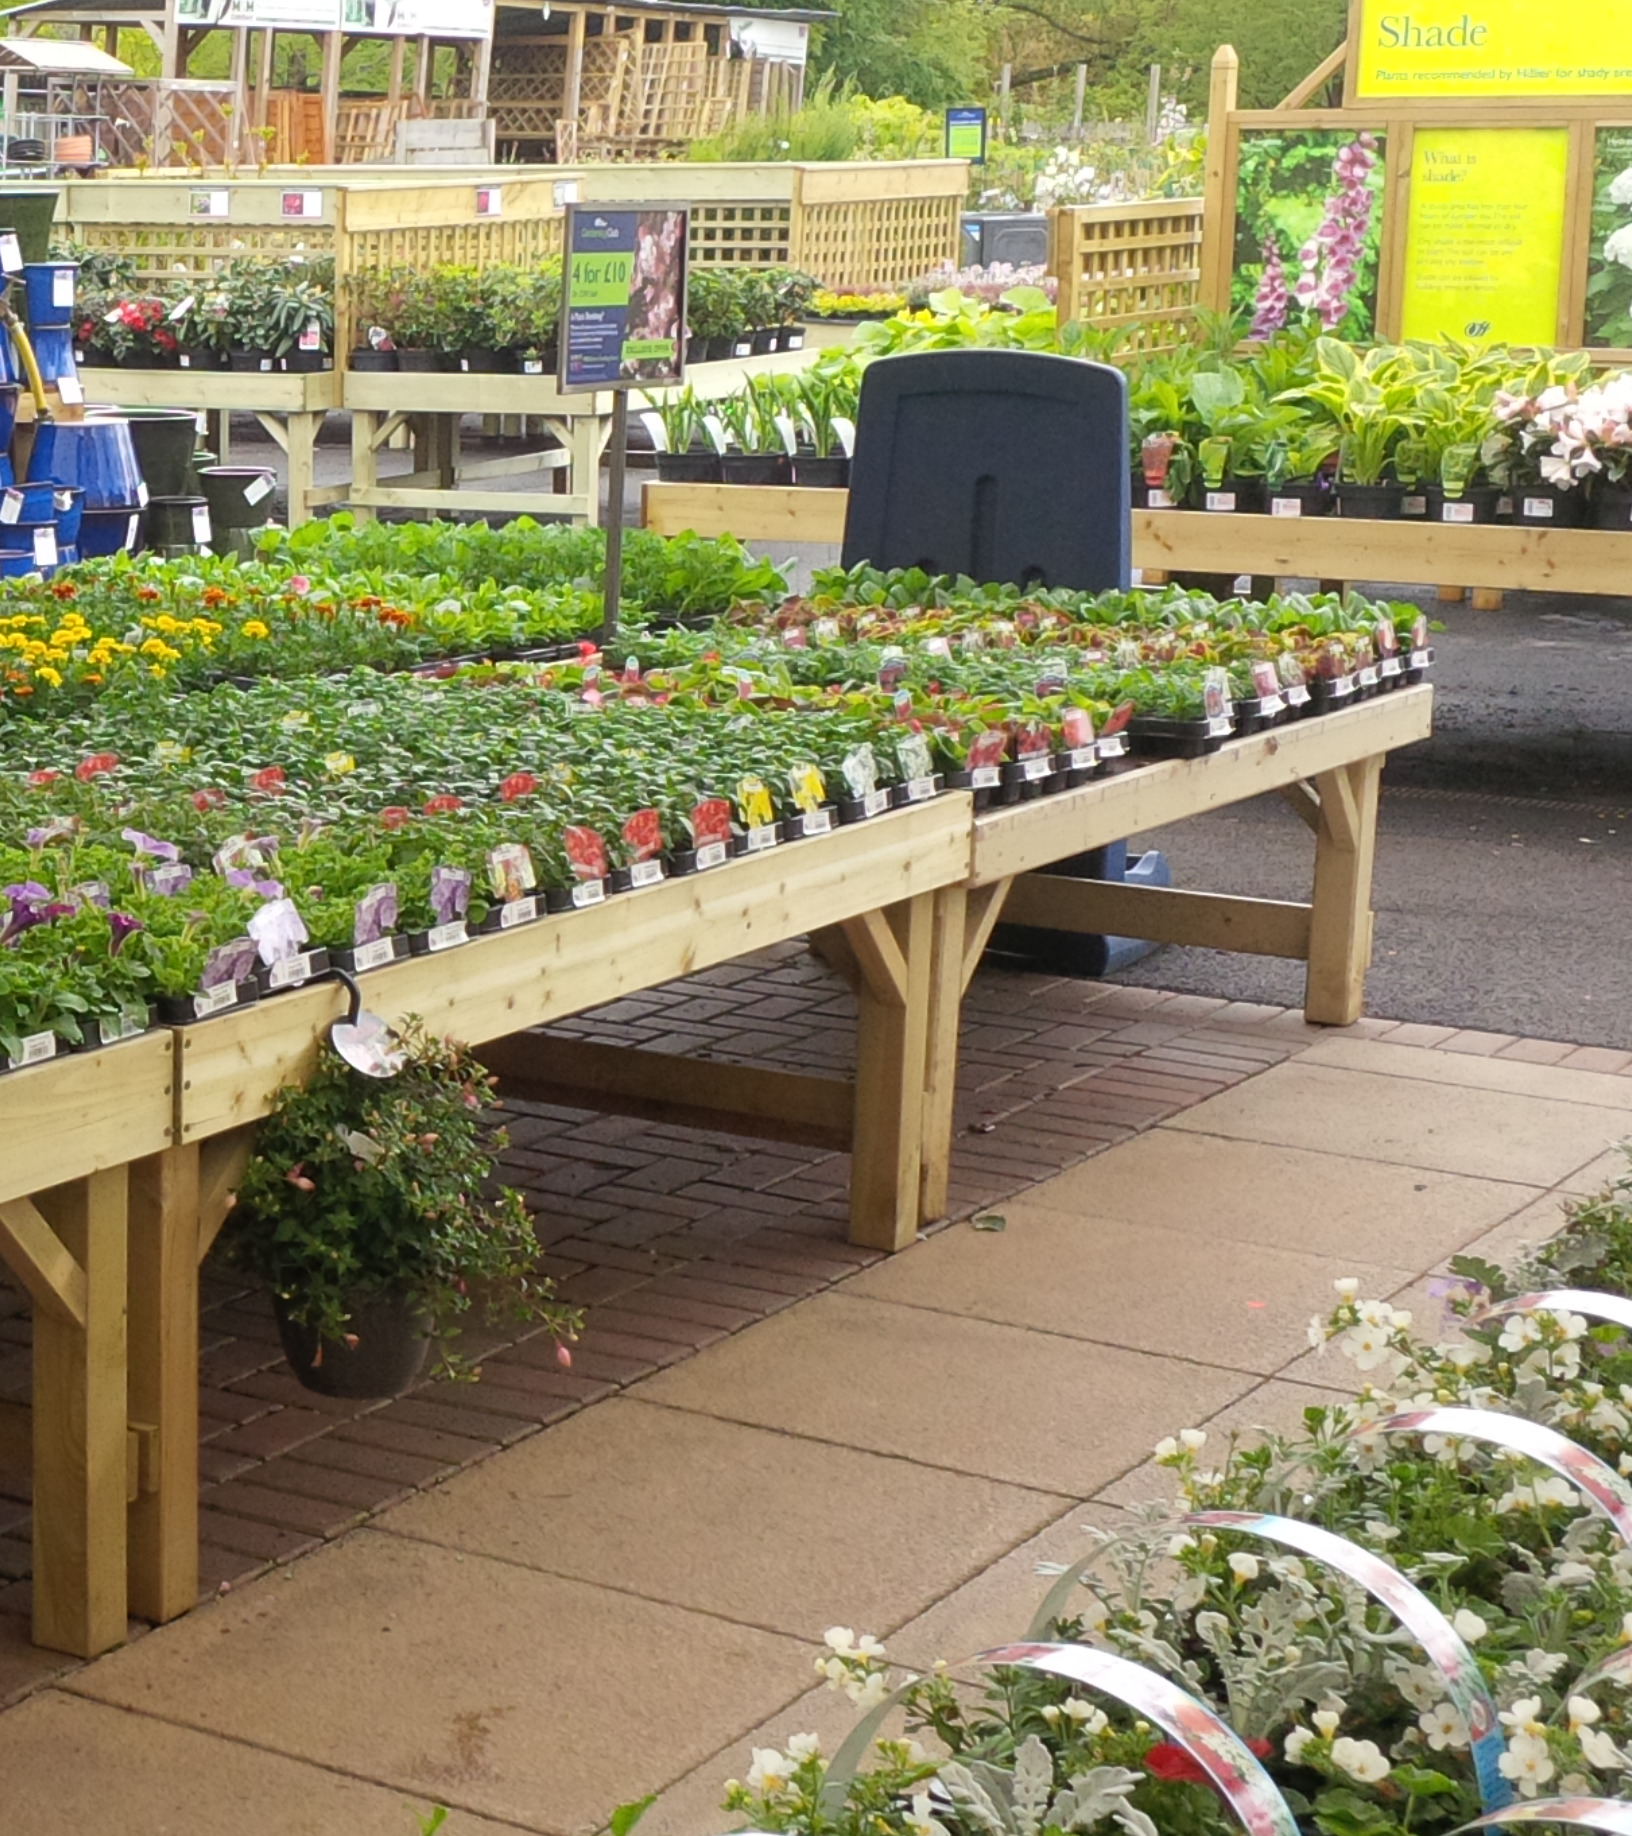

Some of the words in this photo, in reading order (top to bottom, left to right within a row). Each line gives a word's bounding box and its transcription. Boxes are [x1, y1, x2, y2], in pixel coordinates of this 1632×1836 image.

[1377, 14, 1488, 48] Shade
[1413, 69, 1495, 80] recommended
[1499, 70, 1512, 81] by
[1555, 67, 1573, 78] for
[1577, 68, 1610, 81] shady
[572, 261, 581, 284] 4
[584, 261, 602, 285] for
[603, 261, 626, 284] £10
